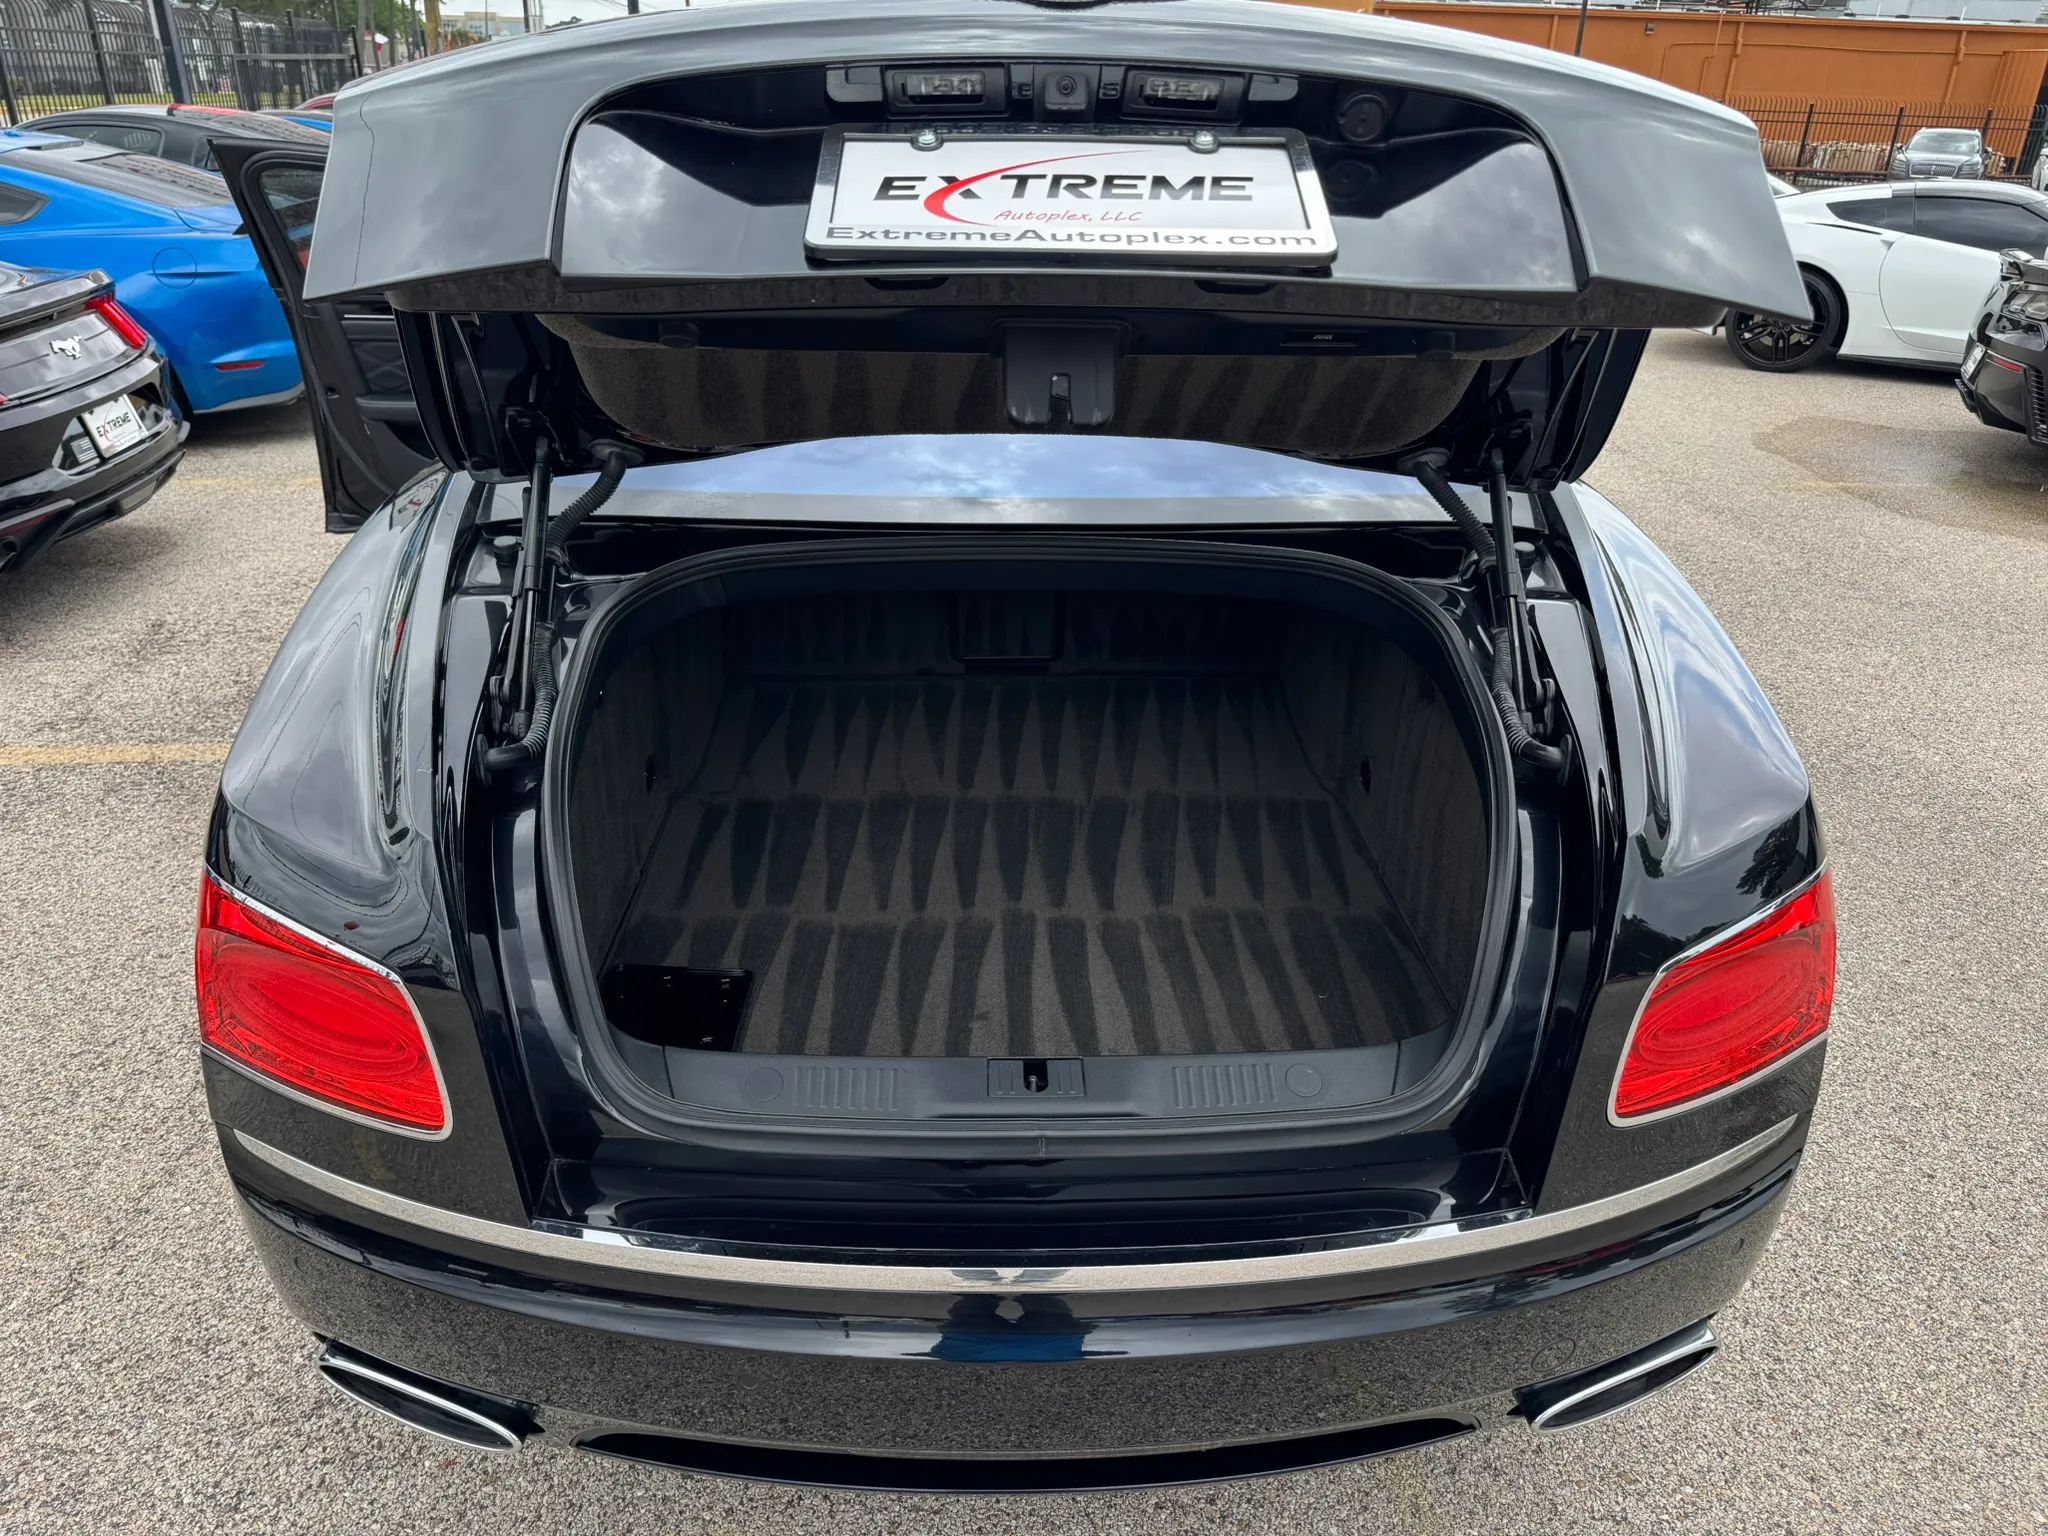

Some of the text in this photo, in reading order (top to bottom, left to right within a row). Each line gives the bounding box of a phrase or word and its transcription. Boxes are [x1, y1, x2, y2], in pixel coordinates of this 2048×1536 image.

[873, 174, 1254, 202] EXTREME
[993, 209, 1143, 223] Autoplex, LLC
[826, 226, 1317, 246] ExtremeAutoplex.com
[95, 411, 132, 438] EXTREME
